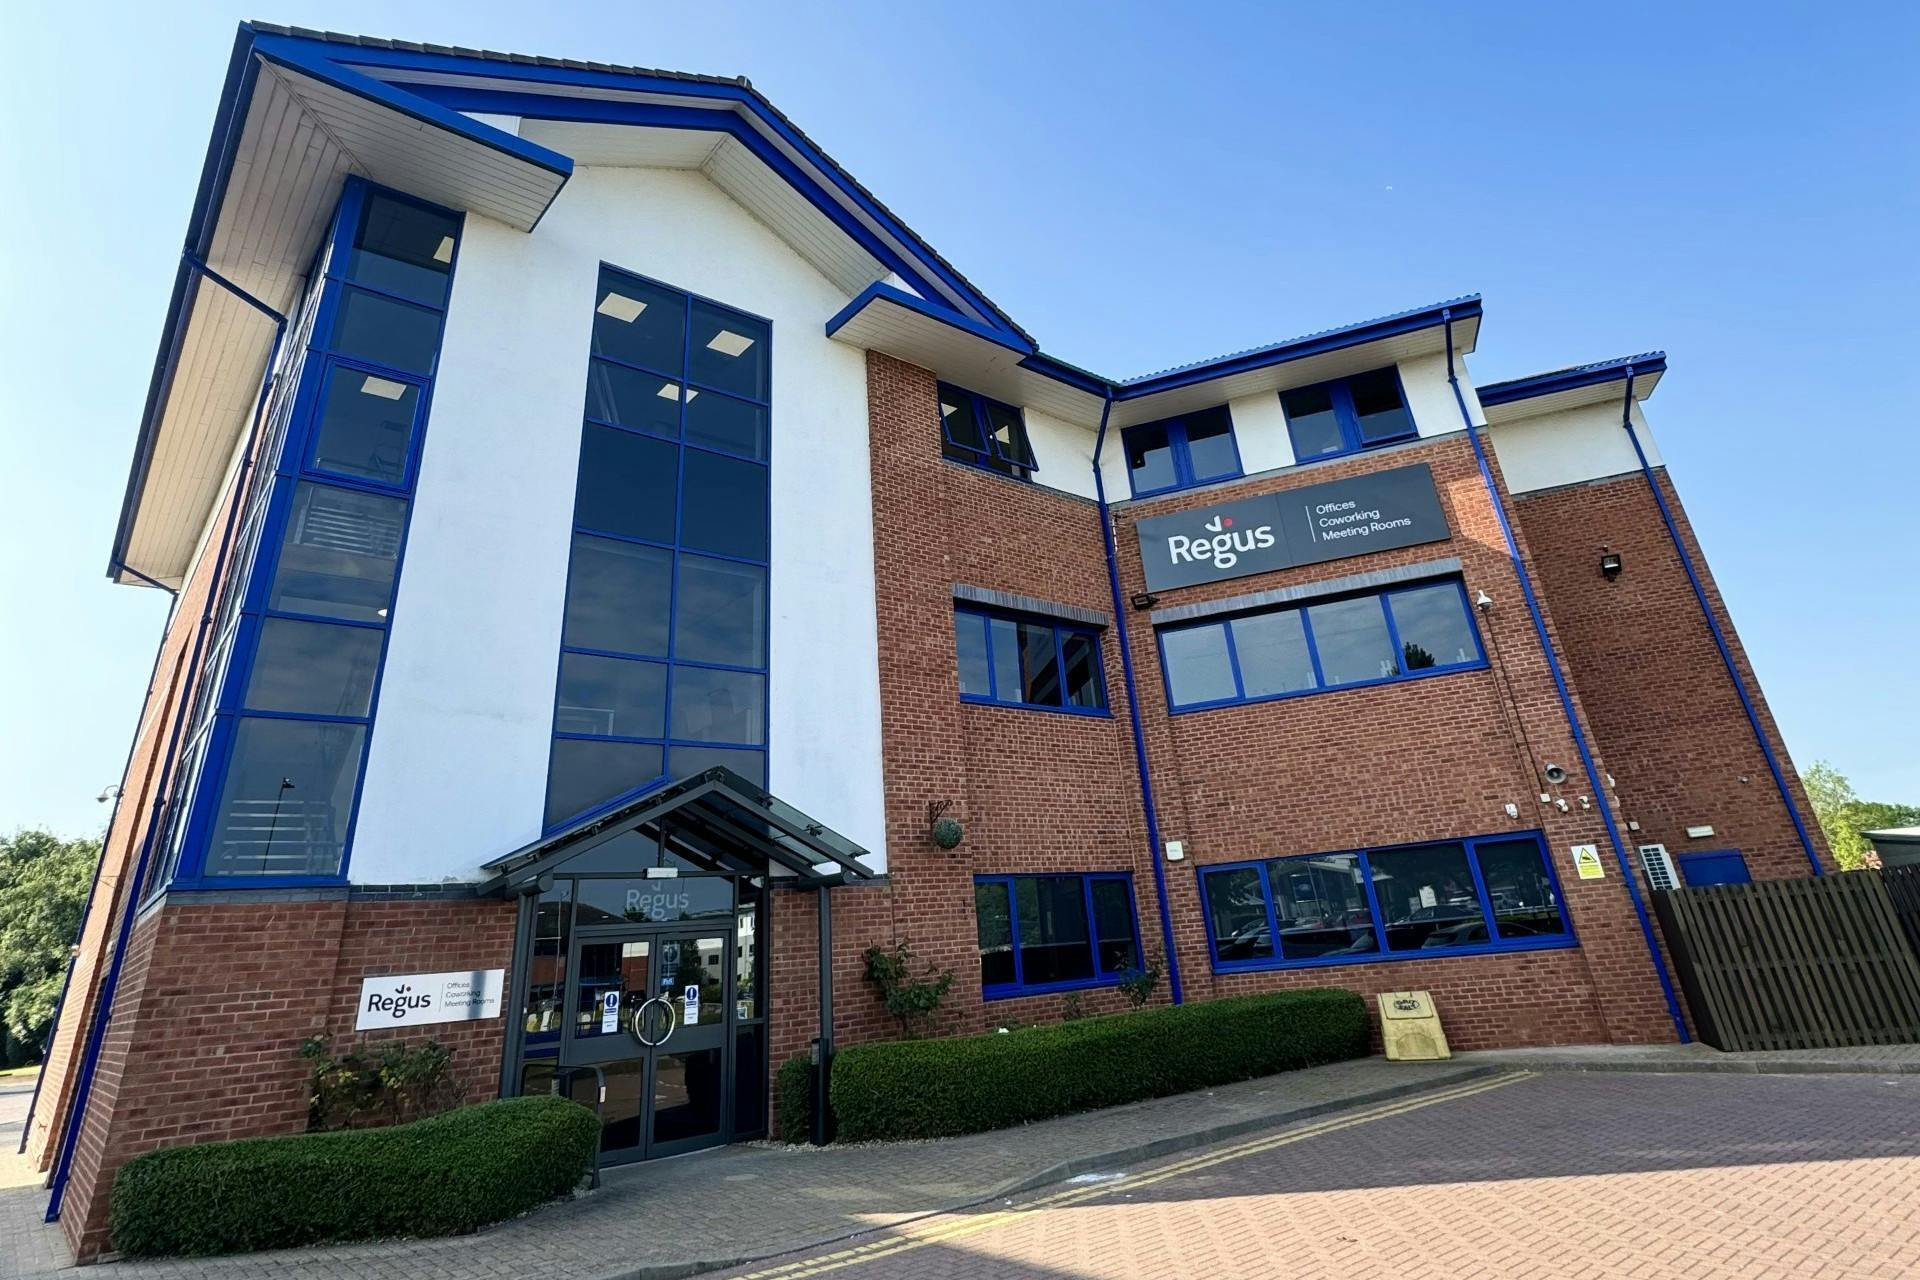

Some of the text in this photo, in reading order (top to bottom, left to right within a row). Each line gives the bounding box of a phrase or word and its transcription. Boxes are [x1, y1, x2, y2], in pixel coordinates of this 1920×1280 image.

[1316, 501, 1356, 514] Offices
[1319, 509, 1380, 527] Coworking
[1322, 518, 1412, 541] Meeting Rooms
[1167, 525, 1275, 569] Regus
[626, 889, 689, 919] Regus
[367, 993, 431, 1018] Regus
